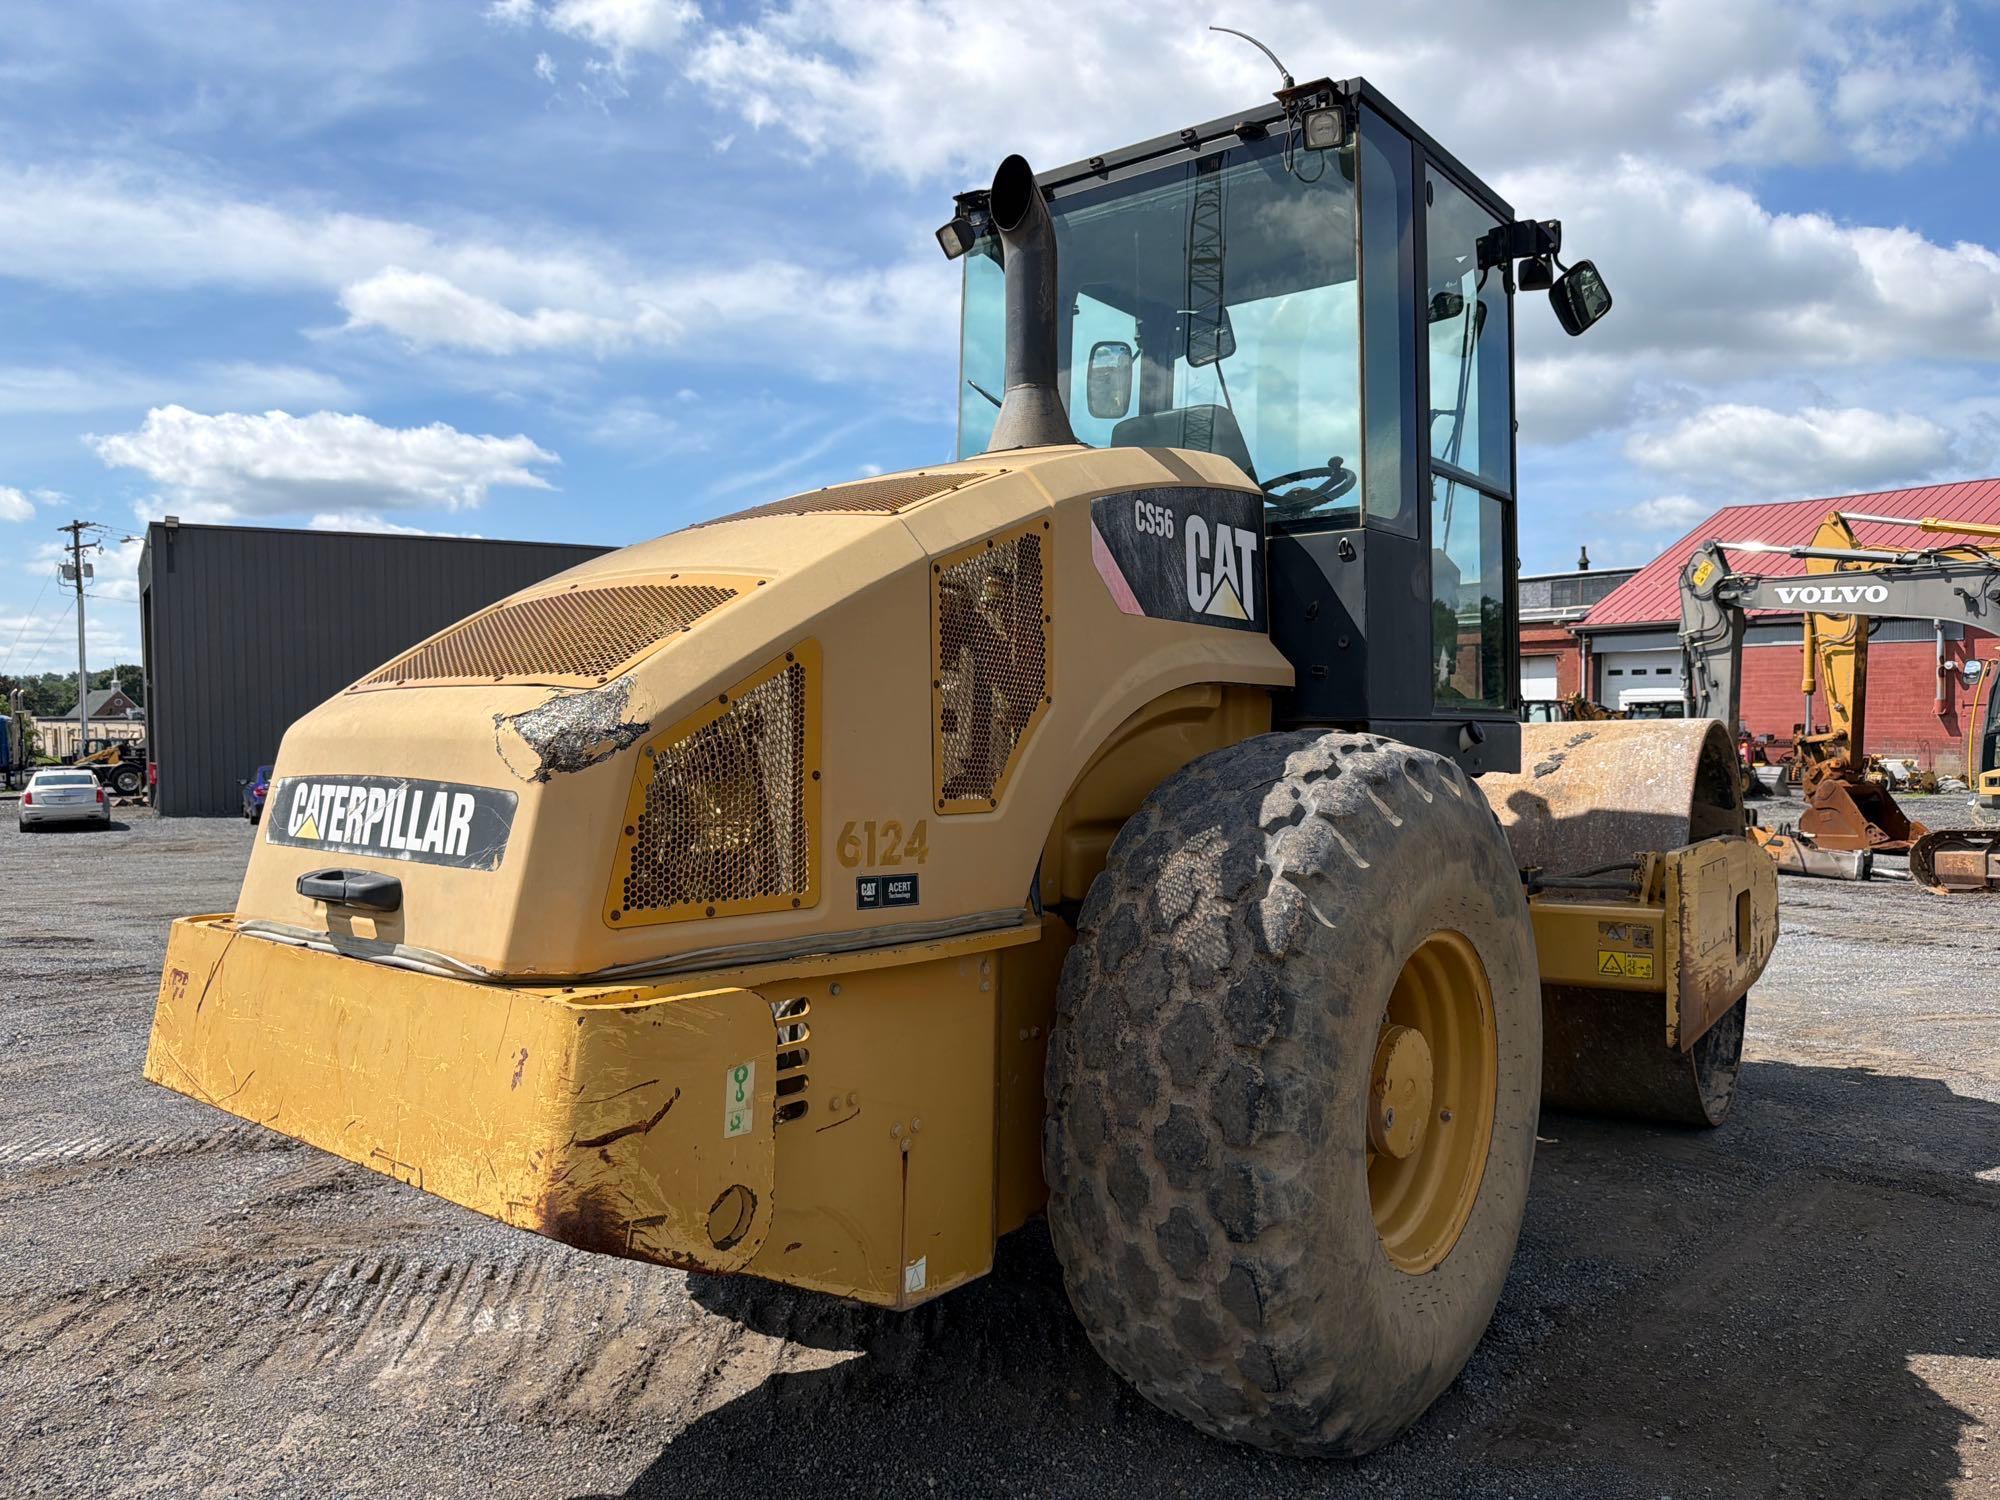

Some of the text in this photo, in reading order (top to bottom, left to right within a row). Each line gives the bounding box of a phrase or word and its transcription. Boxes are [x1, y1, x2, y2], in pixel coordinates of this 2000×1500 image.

[1134, 499, 1174, 539] CS56
[1185, 514, 1257, 621] CAT
[1774, 585, 1888, 604] VOLVO
[288, 782, 475, 856] CATERPILLAR
[836, 819, 929, 868] 6124
[861, 882, 876, 896] CAT
[888, 881, 912, 893] ACERT
